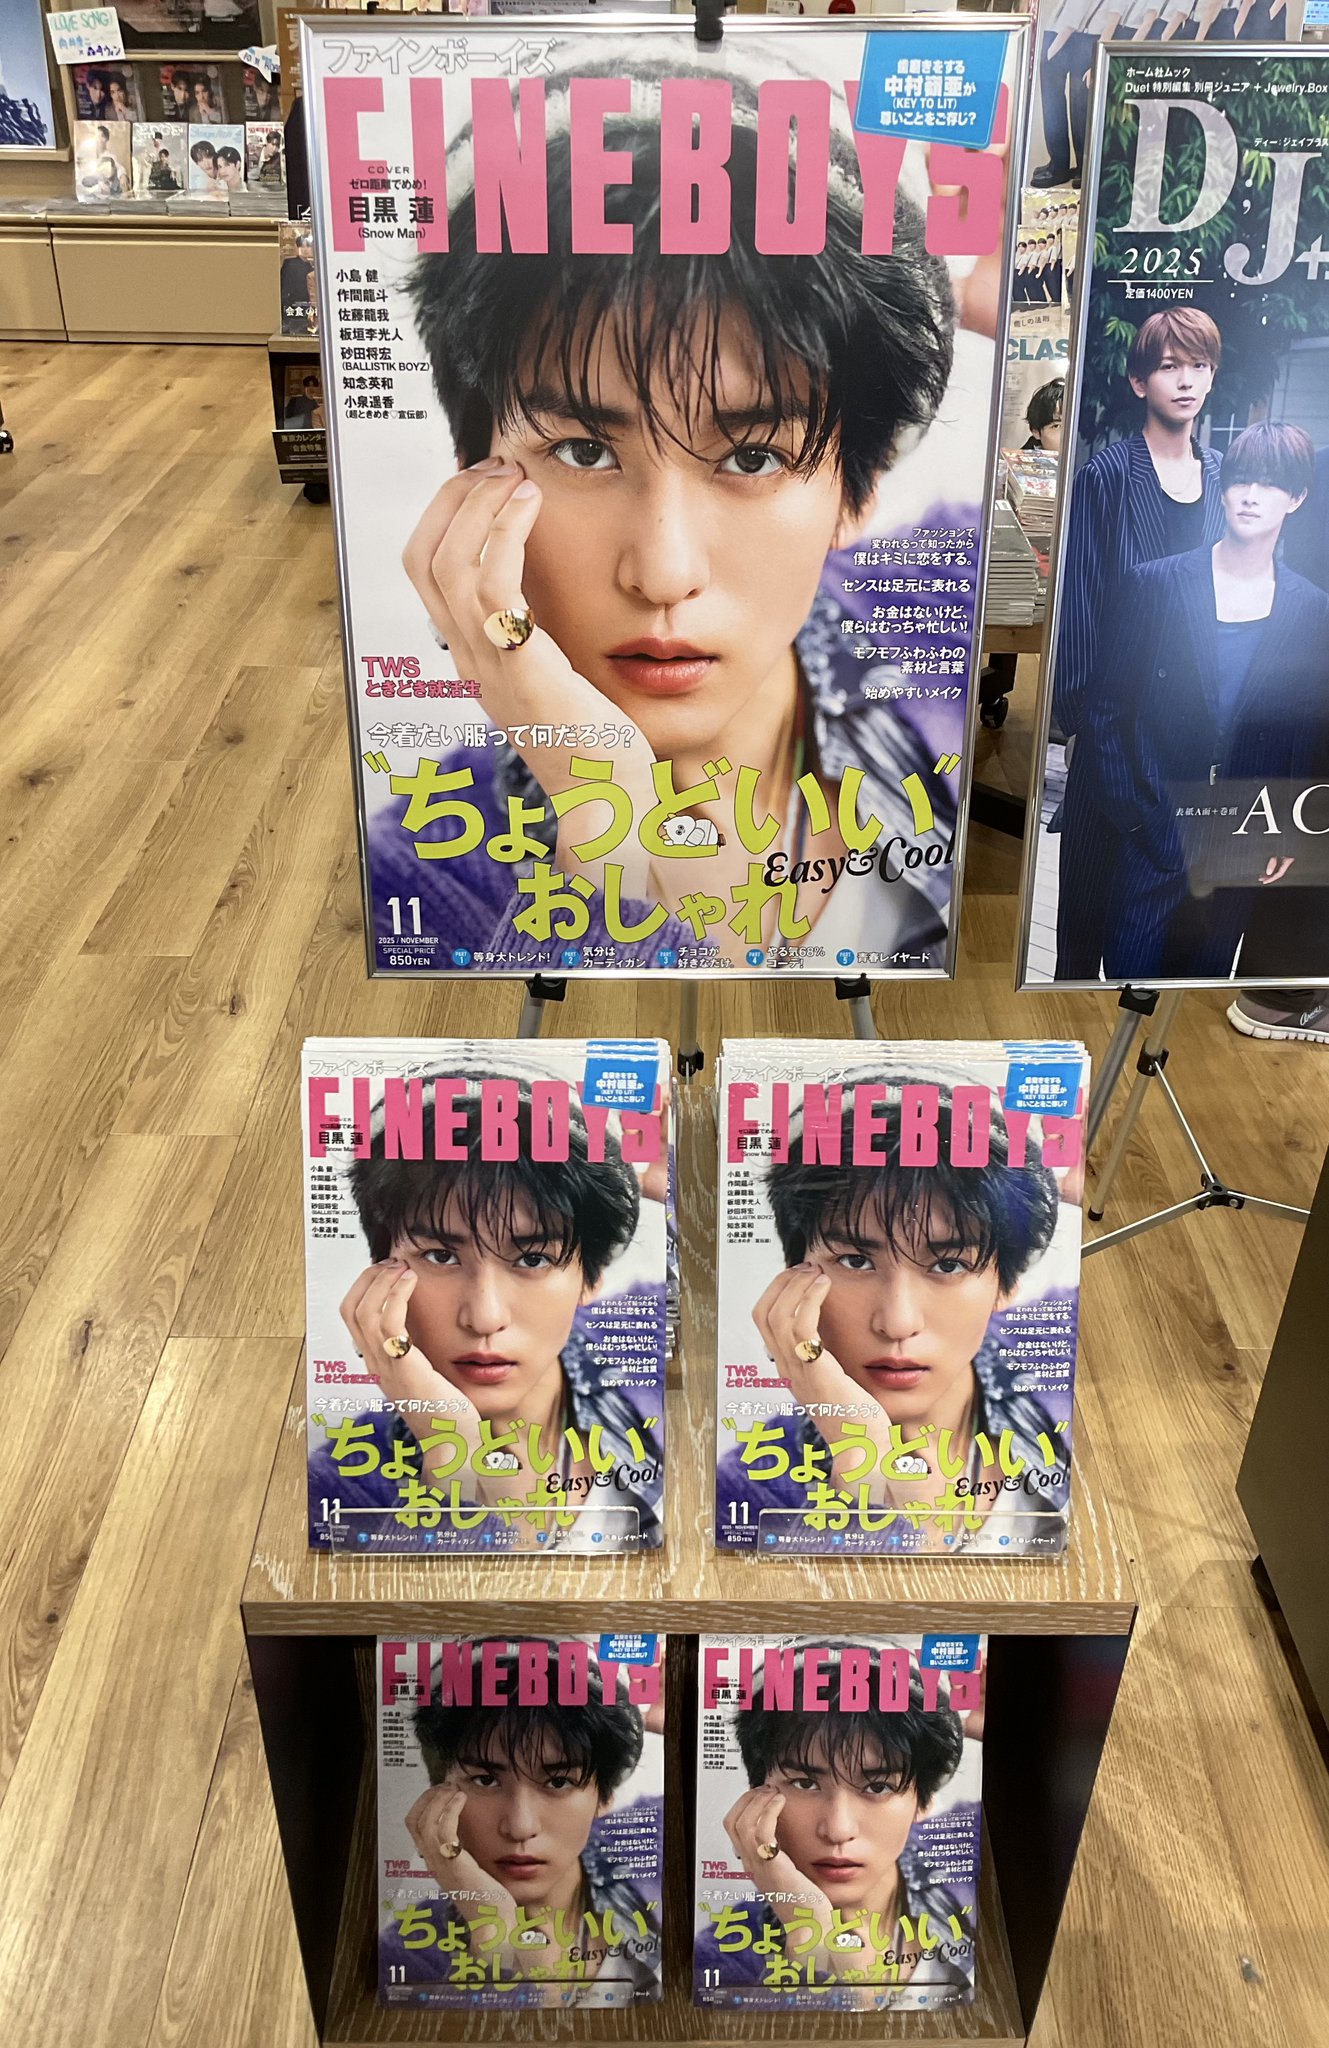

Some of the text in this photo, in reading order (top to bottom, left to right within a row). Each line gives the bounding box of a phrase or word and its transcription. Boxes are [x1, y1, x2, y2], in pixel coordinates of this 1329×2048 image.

[323, 36, 558, 76] ファインボーイズ
[1126, 66, 1191, 79] ホーム社ムック
[1124, 82, 1150, 93] Duet
[1152, 81, 1191, 93] 特別編集
[892, 97, 958, 110] (KEY TO LIT)
[322, 77, 1010, 256] FINEBOYS
[367, 166, 411, 174] COVER
[349, 196, 435, 224] 目黒 蓮
[358, 226, 427, 240] (Snow Man)
[1120, 247, 1204, 278] 2025
[335, 268, 379, 283] 小島 健
[339, 327, 404, 342] 板垣李光人
[342, 361, 431, 372] (BALLISTIK BOYZ)
[342, 376, 394, 391] 知念英和
[912, 527, 976, 538] ファッションで
[871, 539, 975, 550] 変われるって知ったから
[853, 552, 973, 566] 僕はキミに恋をする。
[841, 578, 971, 593] センスは足元に表れる
[872, 605, 968, 620] お金はないけど、
[853, 646, 966, 660] モフモフふわふわの
[361, 656, 421, 678] TWS
[901, 661, 965, 675] 素材と言葉
[365, 679, 482, 699] ときどき就活生
[864, 686, 962, 700] 始めやすいメイク
[512, 861, 813, 945] おしゃれ
[386, 896, 422, 936] 11
[377, 936, 439, 944] 2025 NOVEMBER
[382, 947, 436, 955] SPECIAL PRICE
[582, 946, 617, 957] 気分は
[678, 946, 721, 956] チョコが
[857, 952, 931, 964] 青春レイヤード
[582, 957, 647, 968] カーディガン
[309, 1059, 429, 1077] ファインボーイズ
[729, 1064, 849, 1083] ファインボーイズ
[308, 1076, 662, 1163] FINEBOYS
[727, 1082, 1083, 1168] FINEBOYS
[313, 1360, 347, 1373] TWS
[725, 1364, 758, 1377] TWS
[319, 1497, 341, 1524] 11
[395, 1478, 576, 1530] おしゃれ
[803, 1482, 984, 1532] おしゃれ
[727, 1501, 750, 1525] 11
[382, 1641, 661, 1707] FINEBOYS
[703, 1647, 982, 1713] FINEBOYS
[701, 1860, 728, 1871] TWS
[389, 1965, 406, 1984] 11
[703, 1968, 720, 1988] 11
